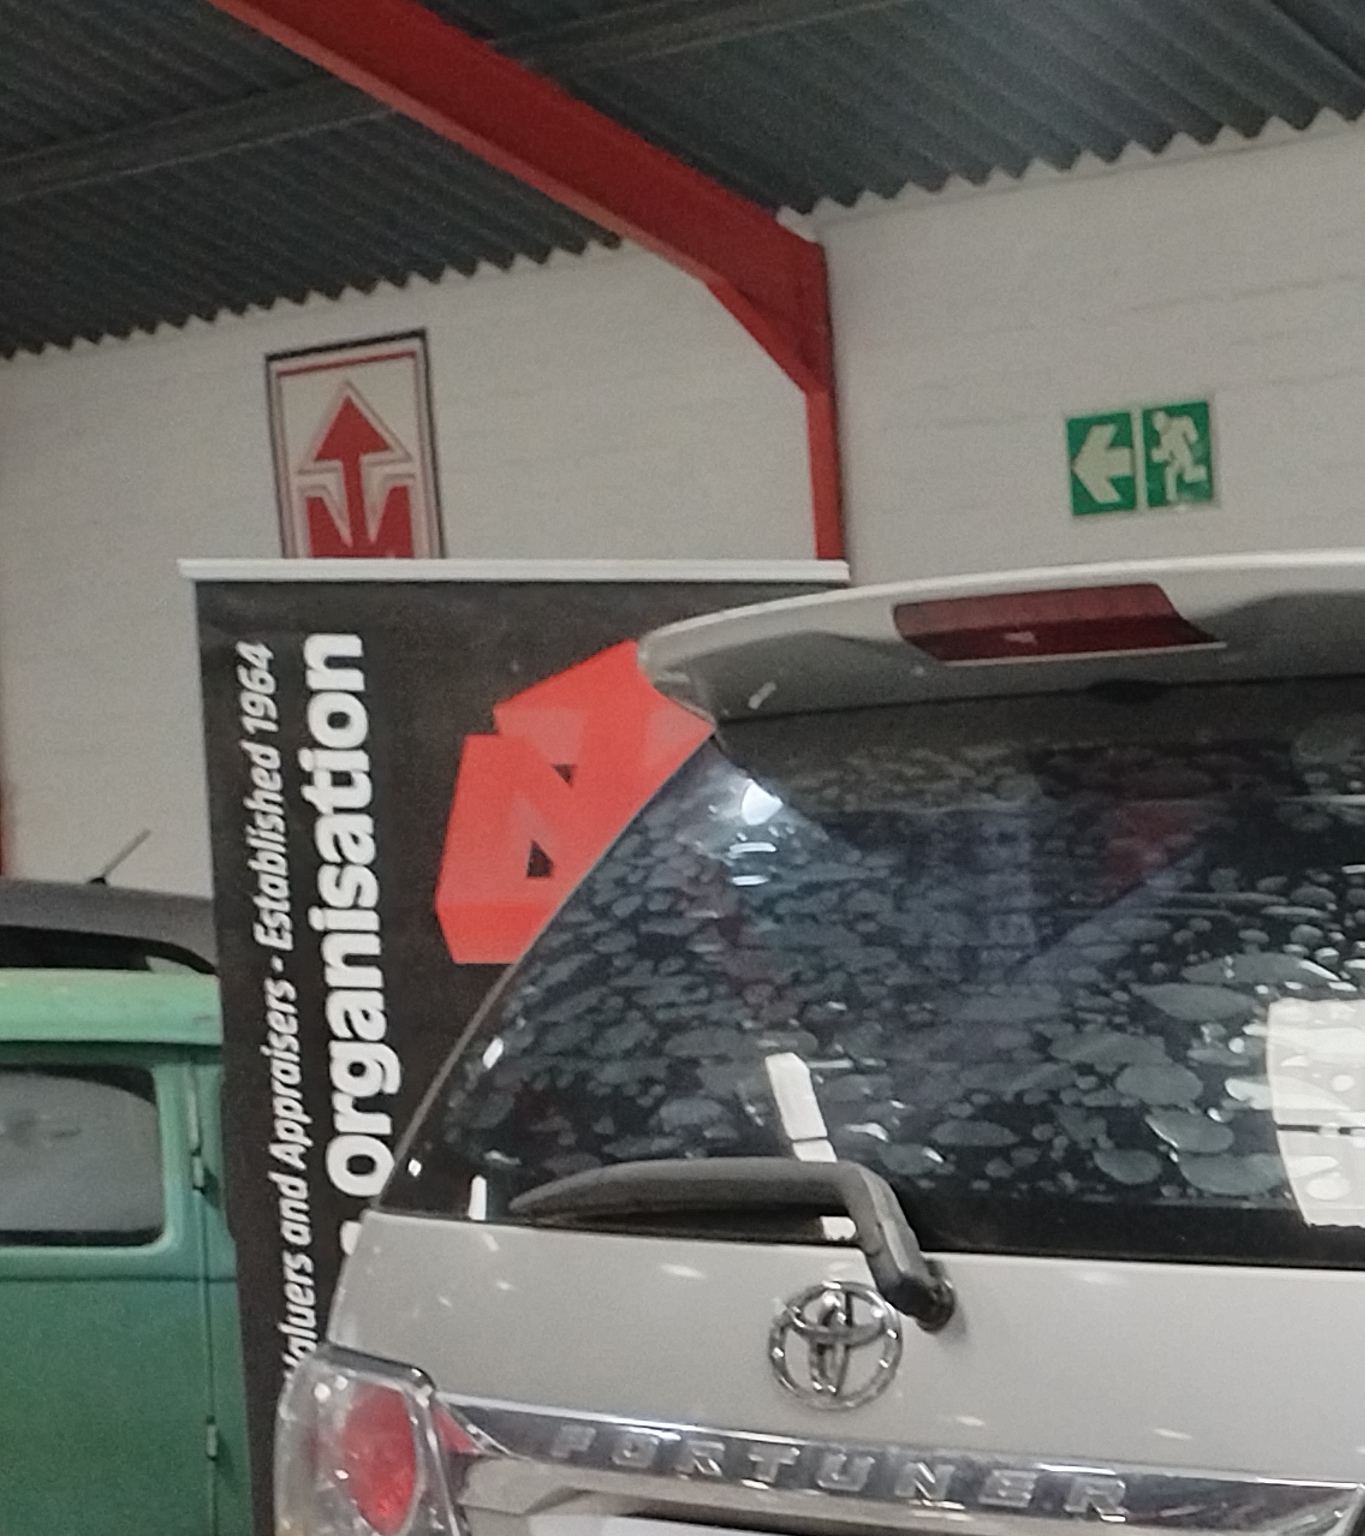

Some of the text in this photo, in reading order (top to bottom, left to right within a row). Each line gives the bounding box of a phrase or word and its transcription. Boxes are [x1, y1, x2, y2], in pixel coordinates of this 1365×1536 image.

[236, 640, 280, 734] 1964
[239, 740, 294, 951] Established
[260, 976, 313, 1170] Appraisers
[268, 1170, 312, 1247] and
[549, 1424, 1128, 1522] FORTUNER
